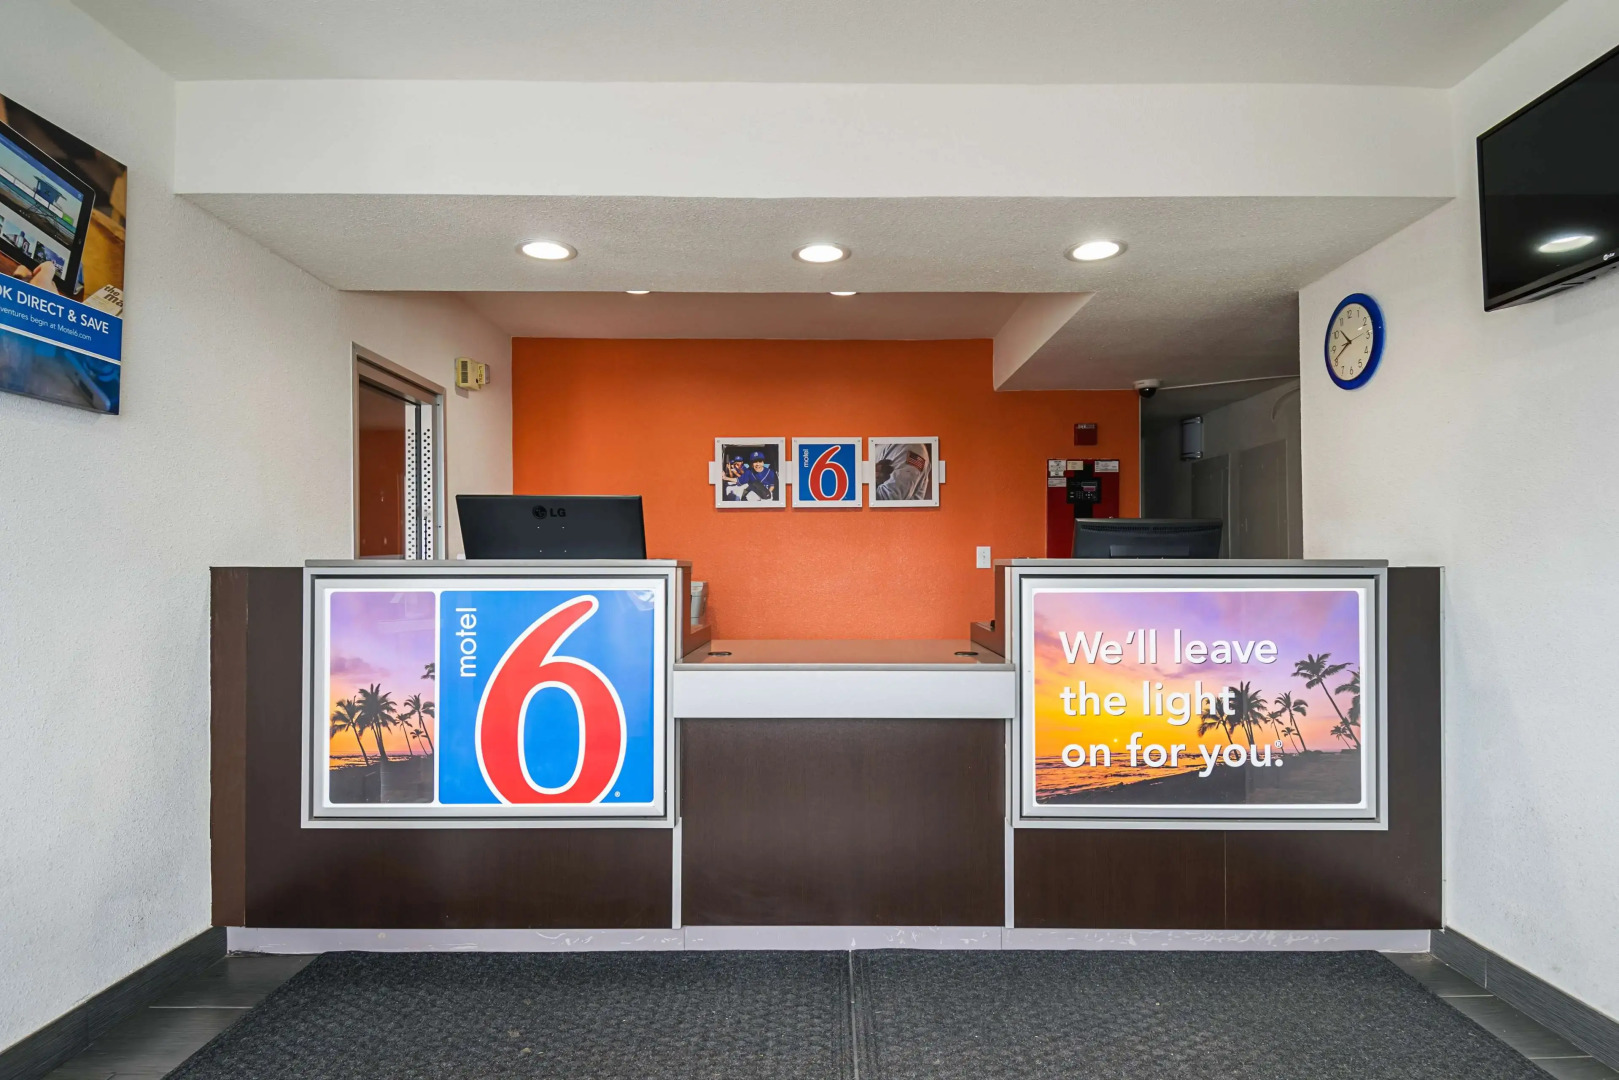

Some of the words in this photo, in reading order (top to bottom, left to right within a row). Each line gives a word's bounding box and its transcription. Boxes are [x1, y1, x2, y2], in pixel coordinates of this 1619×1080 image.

[0, 285, 12, 301] K
[17, 290, 64, 318] DIRECT
[68, 310, 76, 323] &
[80, 314, 109, 334] SAVE
[1346, 310, 1352, 319] 12
[0, 306, 28, 320] ventures
[30, 316, 48, 327] begin
[58, 324, 92, 341] Motel6.com
[1362, 316, 1368, 326] 2
[1334, 330, 1340, 340] 10
[1366, 330, 1371, 340] 3
[1332, 346, 1336, 354] 9
[1364, 346, 1369, 354] 4
[1358, 358, 1362, 368] 5
[1350, 366, 1354, 376] 6
[808, 445, 849, 501] 6
[550, 508, 566, 517] LG
[1174, 629, 1278, 665] leave
[456, 608, 477, 678] motel
[474, 594, 628, 804] 6
[1059, 680, 1127, 716] the
[1142, 680, 1236, 726] light
[1061, 743, 1111, 768] on
[1126, 732, 1186, 768] for
